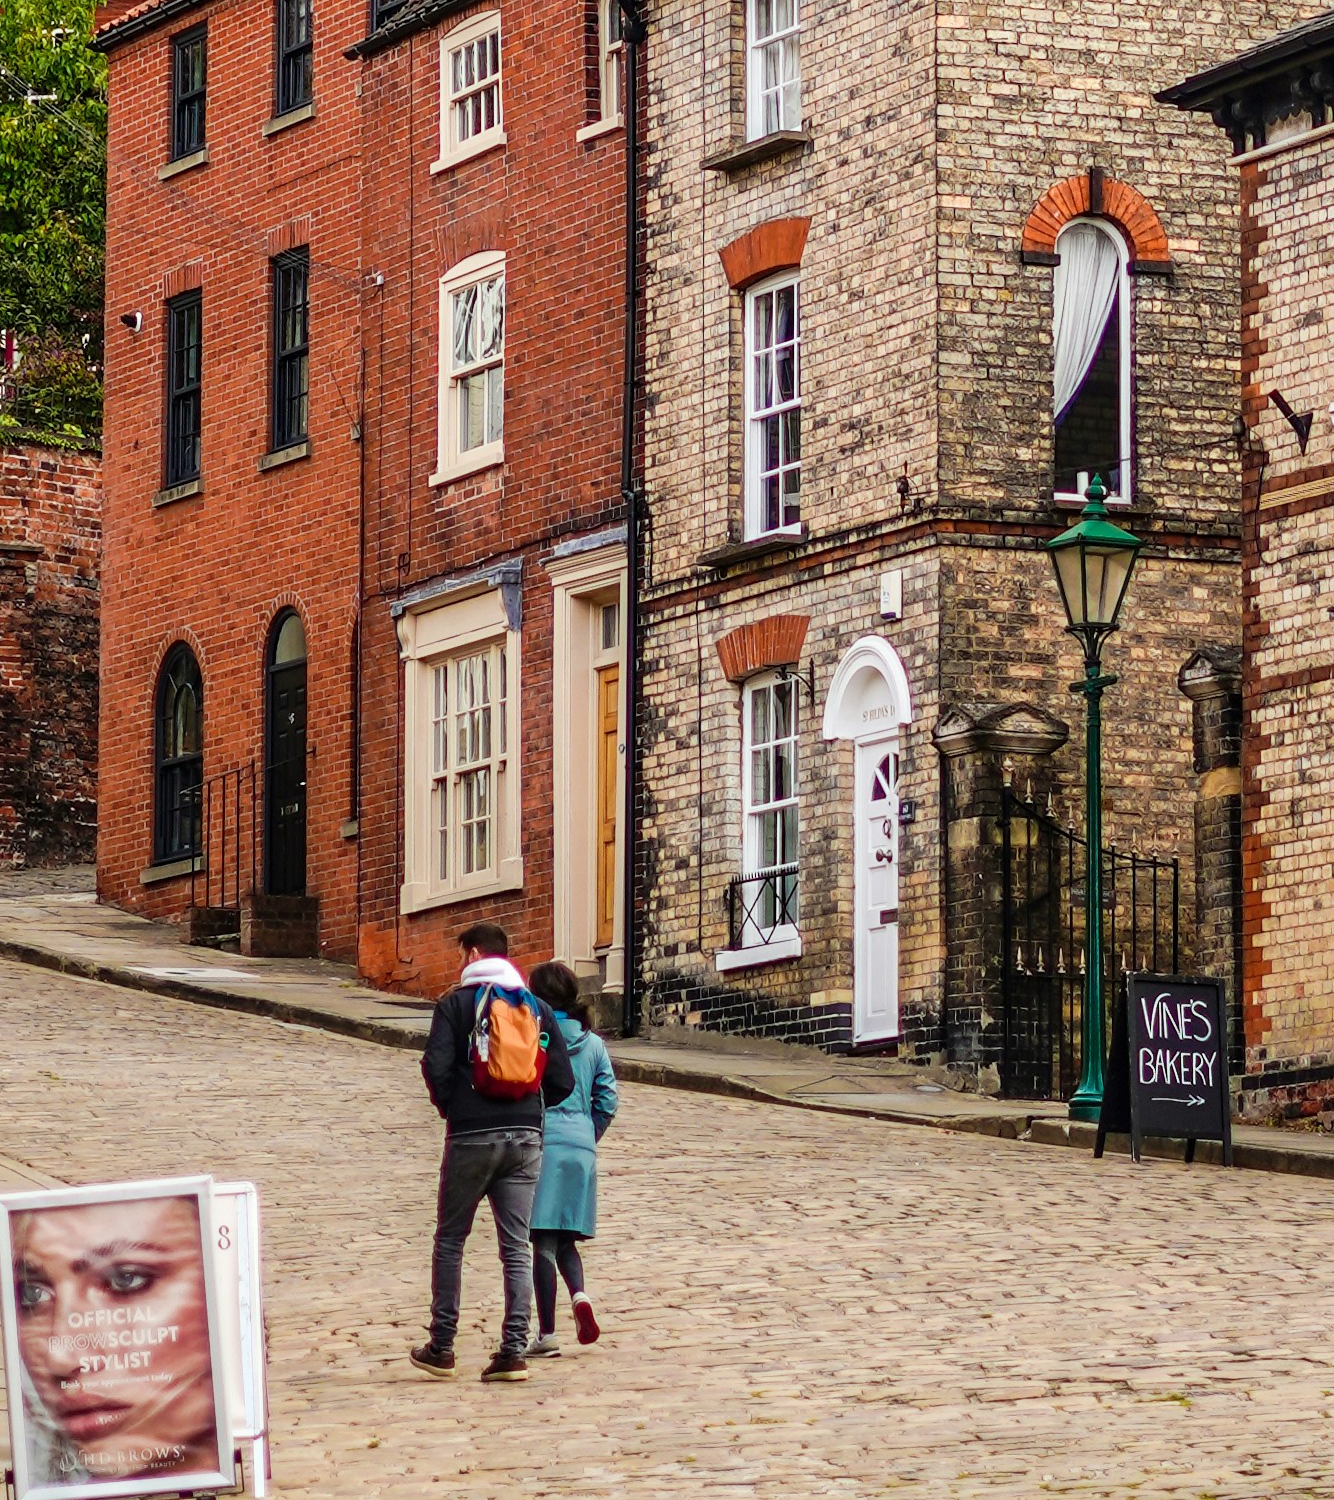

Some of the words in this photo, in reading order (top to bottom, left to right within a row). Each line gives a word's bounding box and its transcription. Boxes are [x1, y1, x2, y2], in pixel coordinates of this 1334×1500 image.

[1140, 992, 1212, 1042] VINE'S
[1139, 1047, 1217, 1087] BAKERY
[67, 1305, 156, 1329] OFFICIAL
[48, 1325, 179, 1354] BROWSCULPT
[78, 1350, 151, 1374] STYLIST
[84, 1451, 112, 1466] HD
[117, 1444, 181, 1463] BROWS
